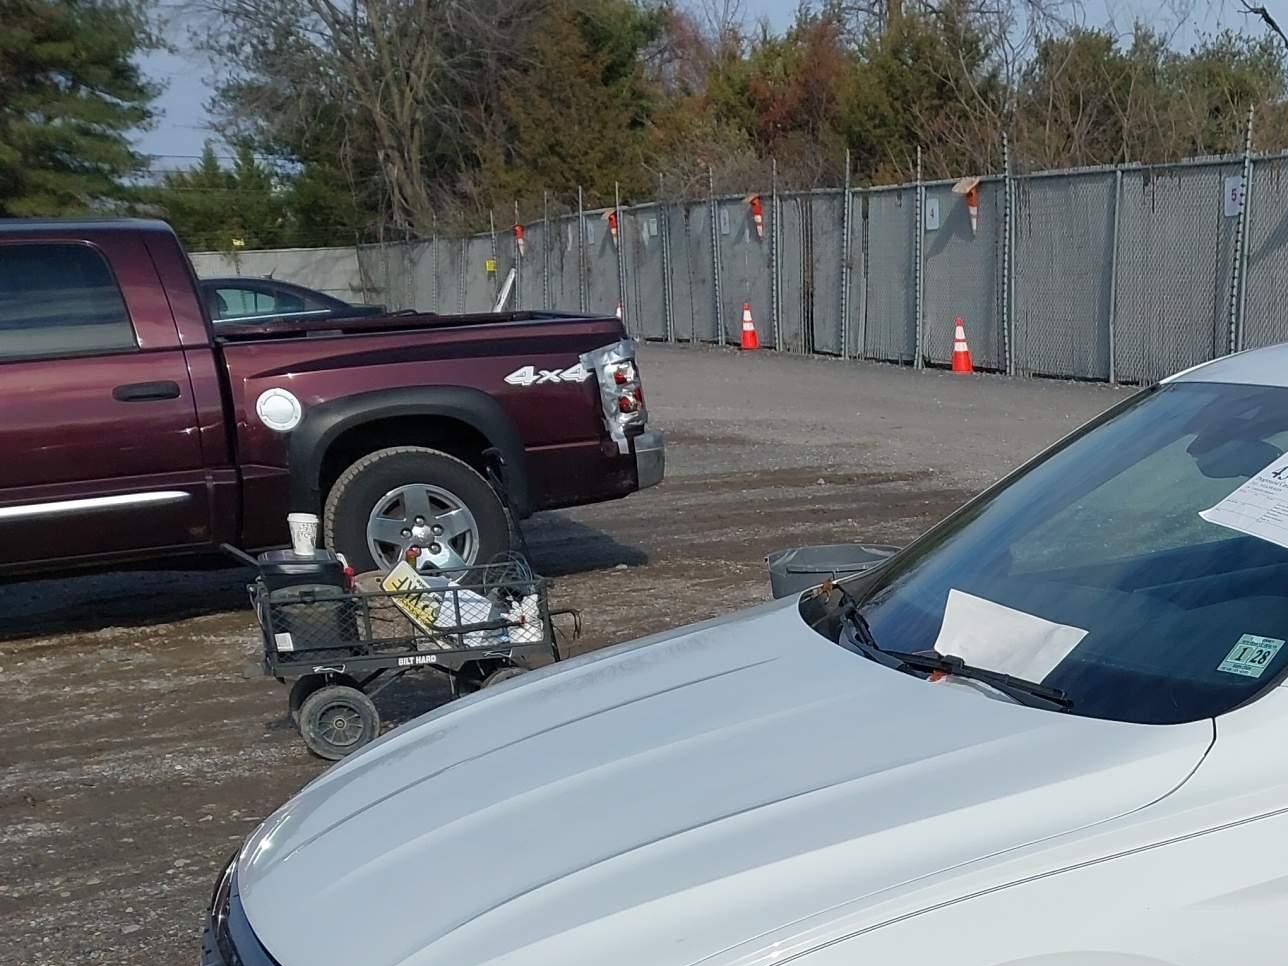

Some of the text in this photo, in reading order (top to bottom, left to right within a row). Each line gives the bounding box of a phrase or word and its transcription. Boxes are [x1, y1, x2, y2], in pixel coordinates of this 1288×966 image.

[503, 363, 595, 387] 4x4
[398, 656, 415, 666] BILT
[1234, 647, 1271, 665] 1 28
